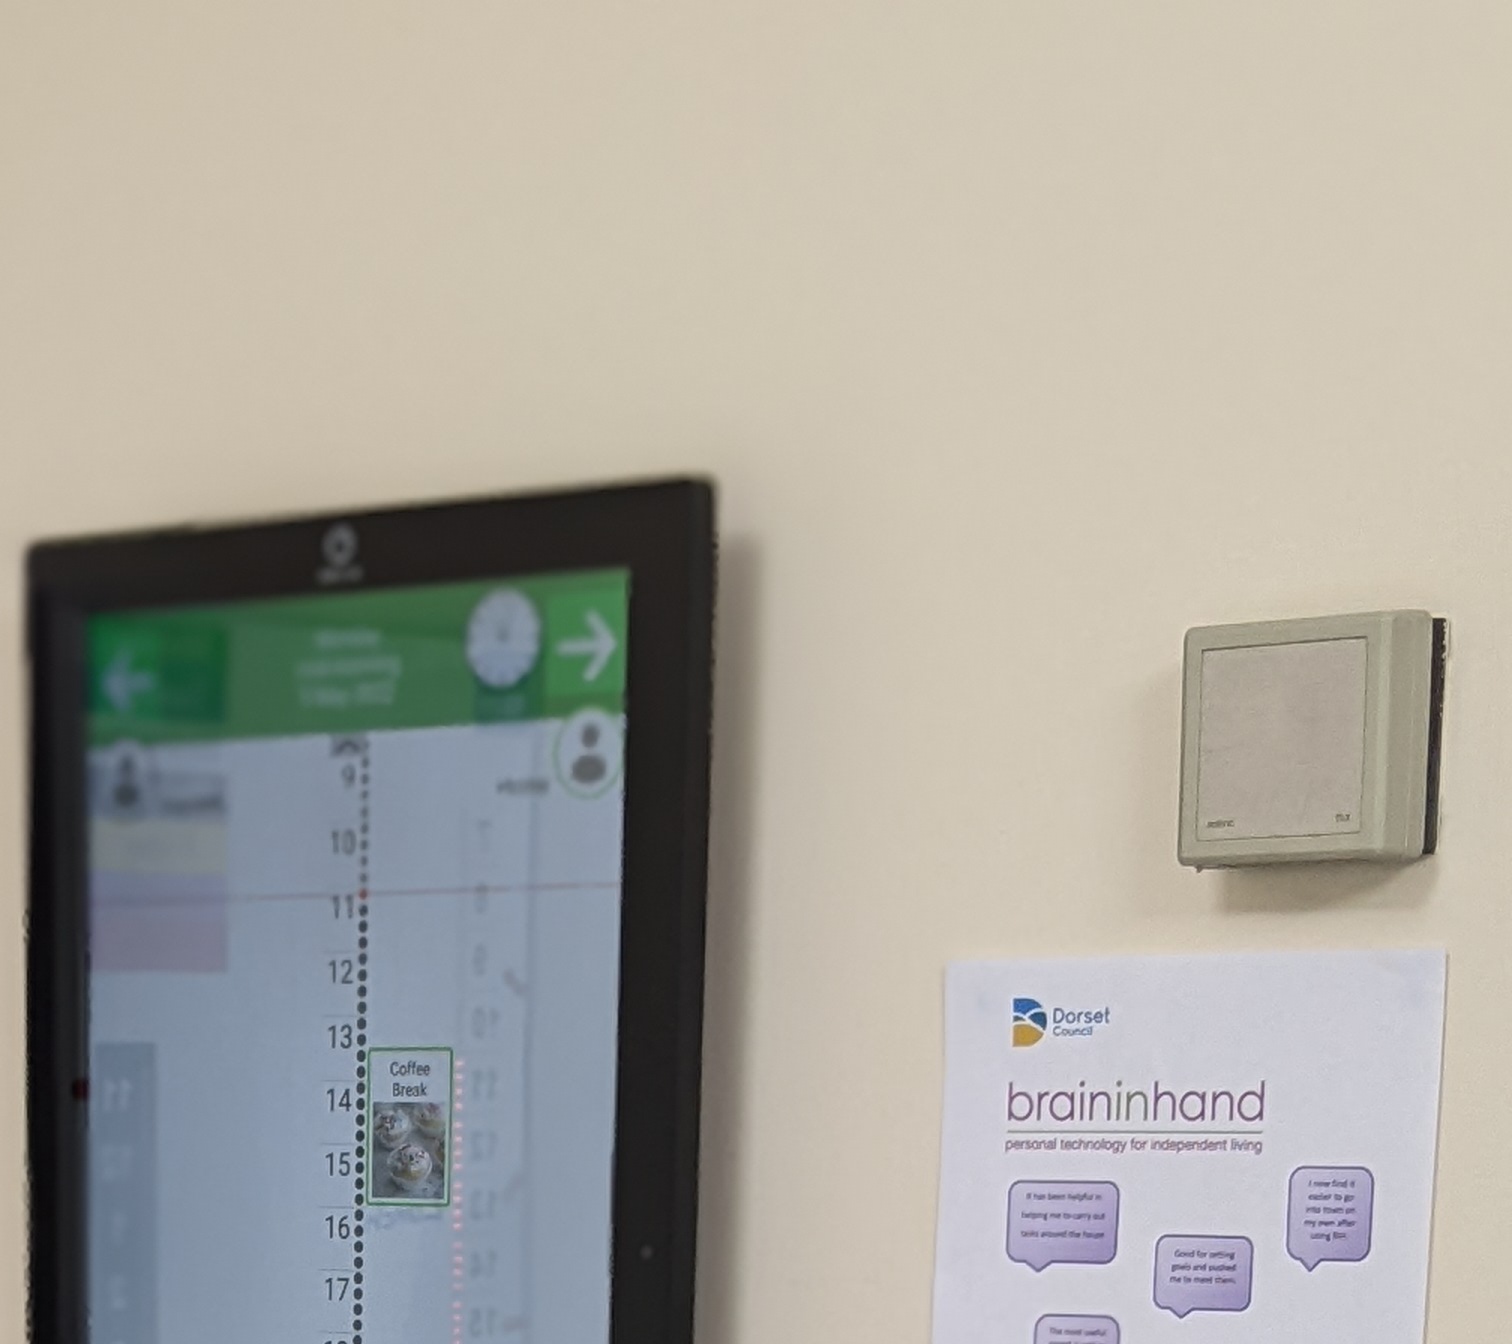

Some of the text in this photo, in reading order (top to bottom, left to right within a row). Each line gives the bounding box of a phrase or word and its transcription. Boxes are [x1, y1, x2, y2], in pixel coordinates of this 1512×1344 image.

[329, 829, 357, 857] 10
[332, 895, 355, 920] 11
[328, 958, 354, 986] 12
[1052, 1007, 1110, 1025] Dorset
[327, 1024, 354, 1051] 13
[1052, 1026, 1094, 1037] Council
[389, 1060, 431, 1078] Coffee
[326, 1086, 353, 1113] 14
[391, 1081, 428, 1099] Break
[1007, 1080, 1266, 1122] braininhand
[1005, 1137, 1263, 1155] personal technology for independent living
[324, 1151, 352, 1178] 15
[324, 1214, 351, 1240] 16
[324, 1277, 350, 1302] 17
